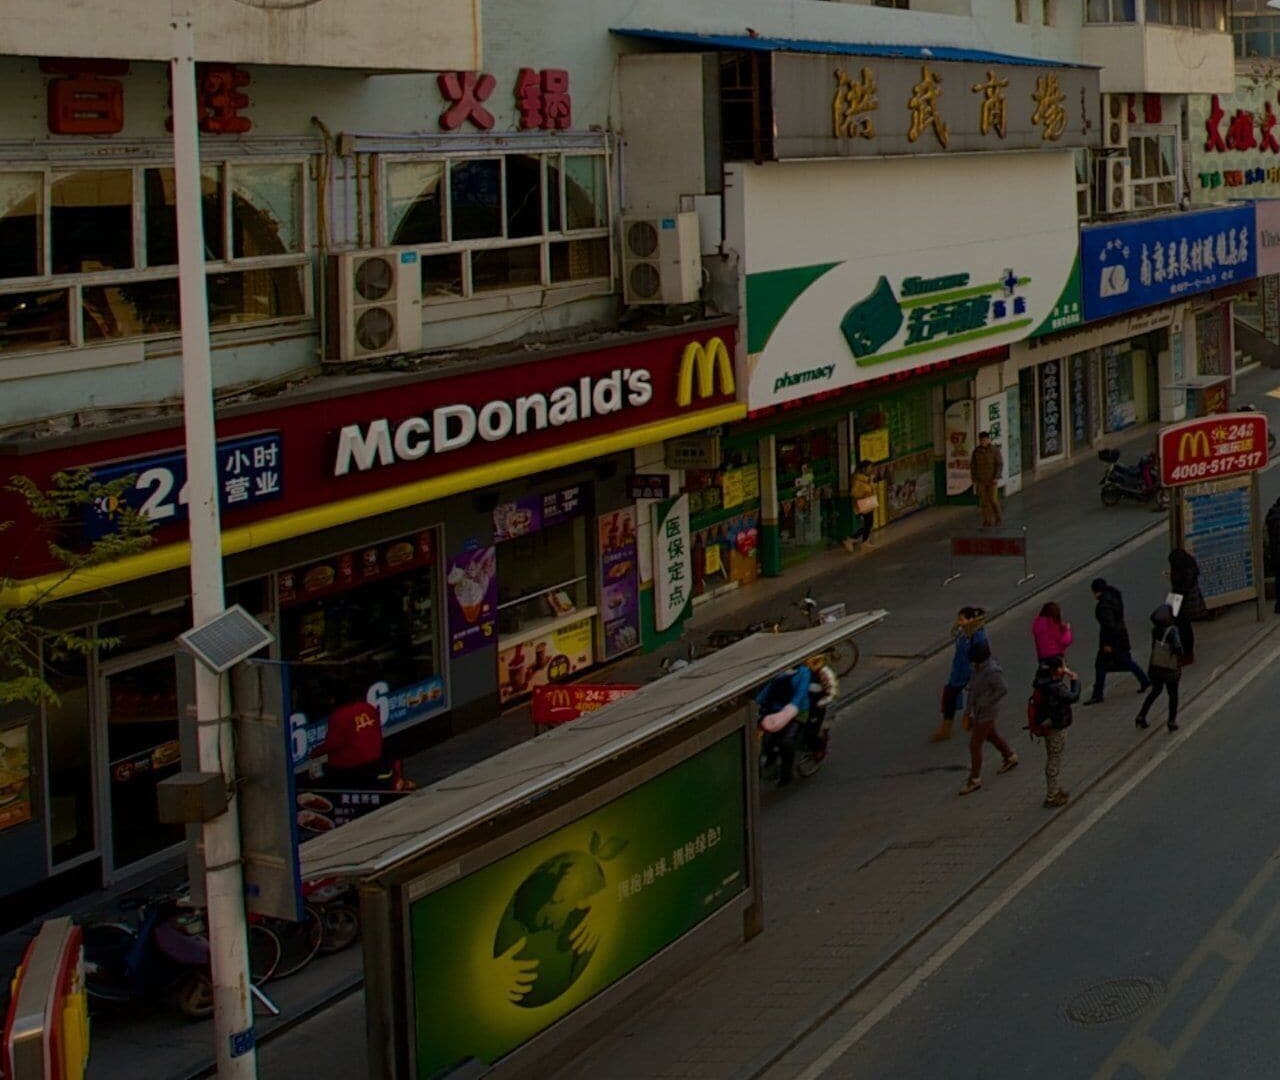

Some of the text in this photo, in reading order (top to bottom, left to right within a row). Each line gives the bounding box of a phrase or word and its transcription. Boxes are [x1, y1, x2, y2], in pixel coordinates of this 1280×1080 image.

[436, 67, 573, 132] 火锅
[773, 364, 837, 394] pharmacy
[333, 366, 653, 477] McDonald's
[224, 443, 280, 475] 小时
[223, 470, 281, 504] 营业
[665, 515, 686, 611] 医保定点
